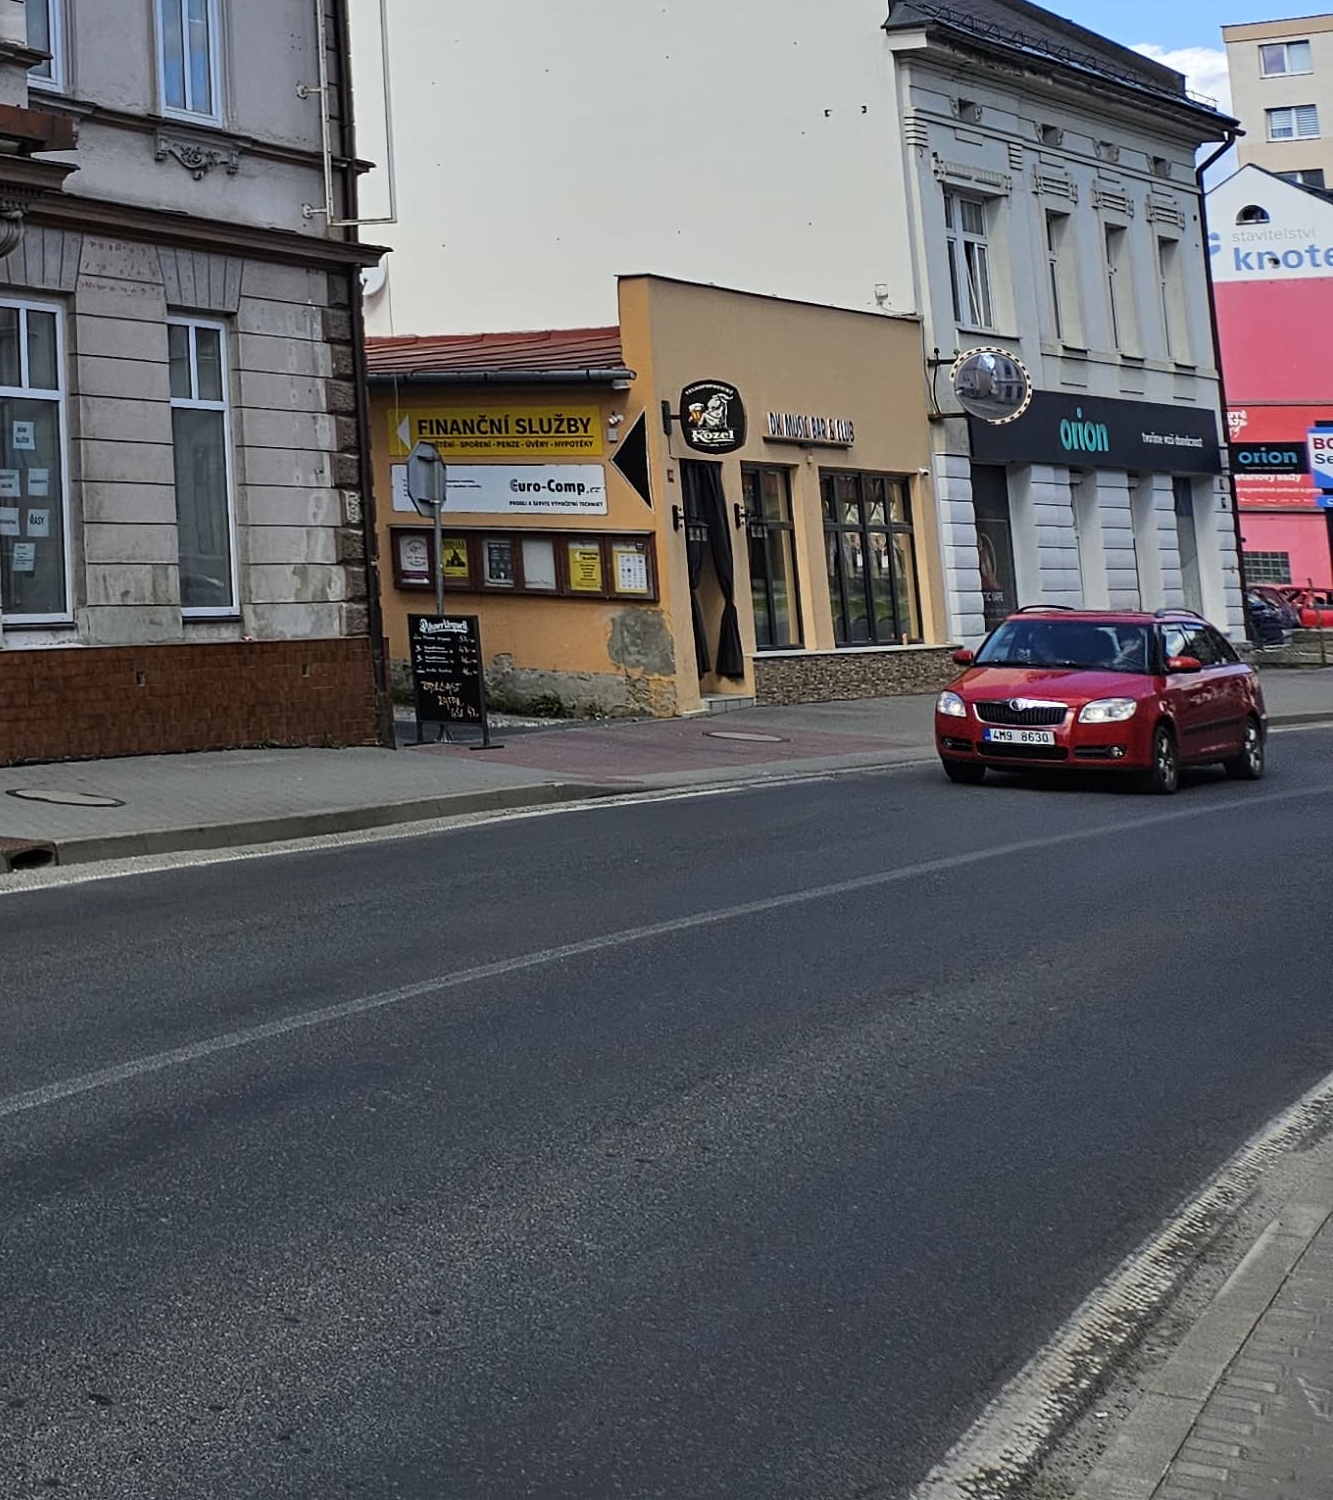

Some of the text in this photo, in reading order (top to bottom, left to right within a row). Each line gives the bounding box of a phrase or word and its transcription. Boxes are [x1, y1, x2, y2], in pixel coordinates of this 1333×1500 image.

[417, 413, 592, 436] FINANČNÍ SLUŽBY
[809, 416, 827, 440] BAR
[1060, 406, 1109, 452] orion
[692, 429, 735, 443] Kozel
[1238, 446, 1298, 465] orion
[993, 730, 1049, 742] 4M9 8630
